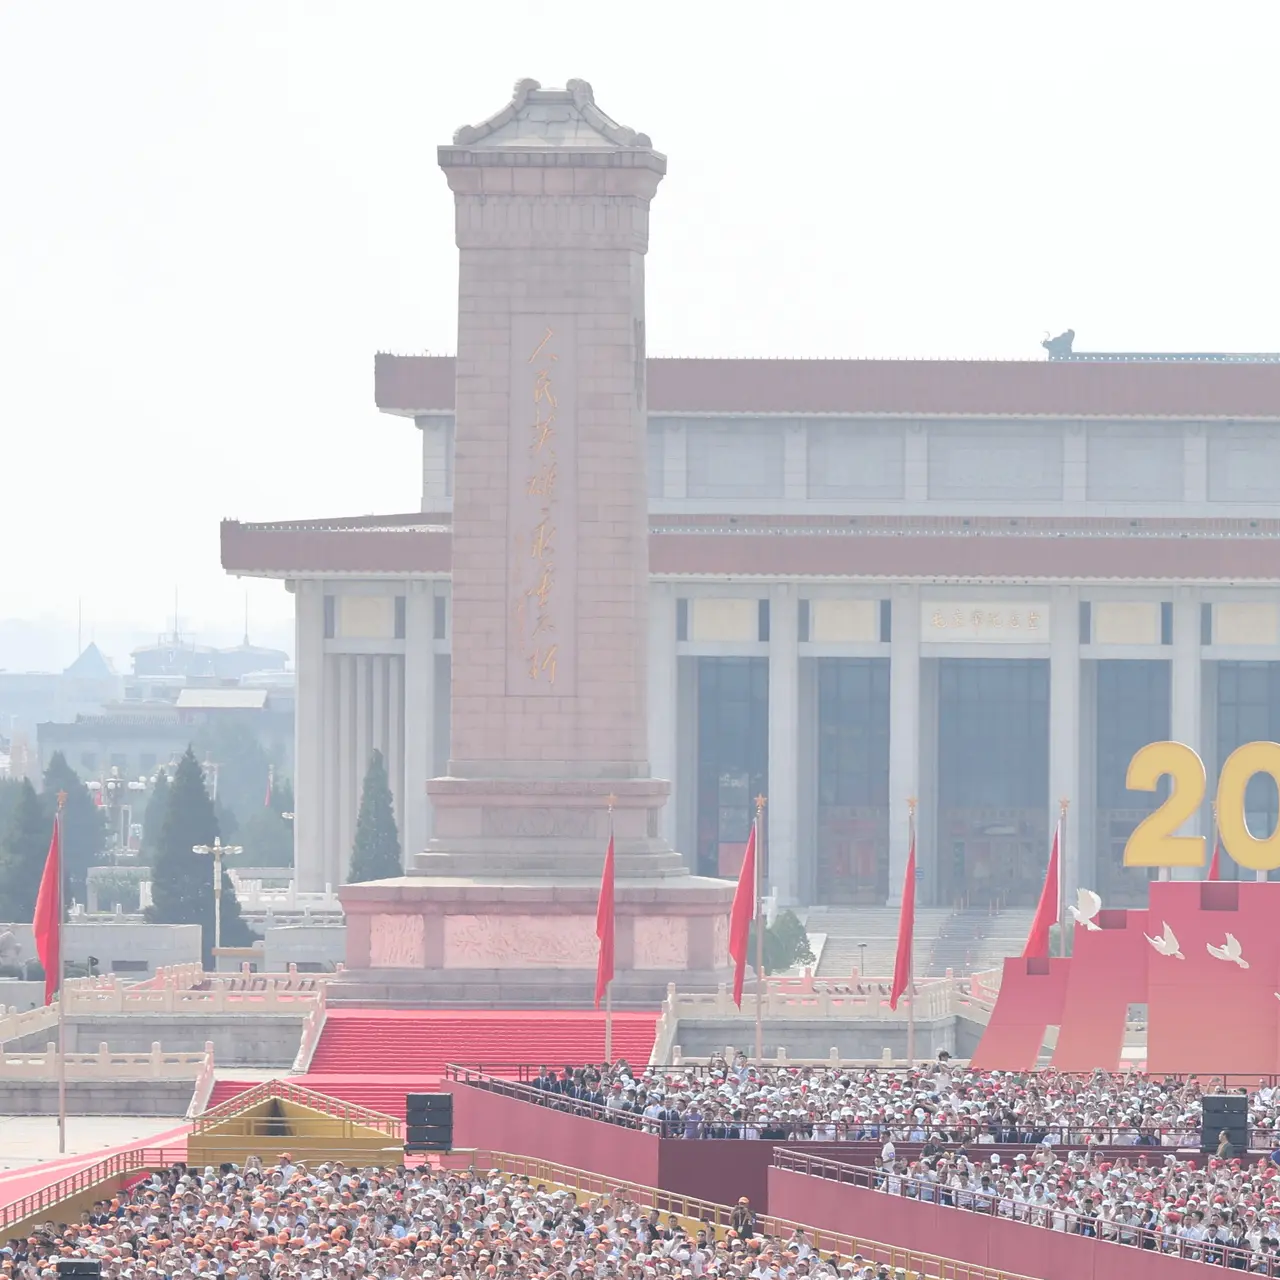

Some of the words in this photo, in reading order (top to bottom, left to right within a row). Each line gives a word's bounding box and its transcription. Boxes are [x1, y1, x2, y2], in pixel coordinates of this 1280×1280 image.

[525, 327, 560, 684] 人民英雄永垂不朽
